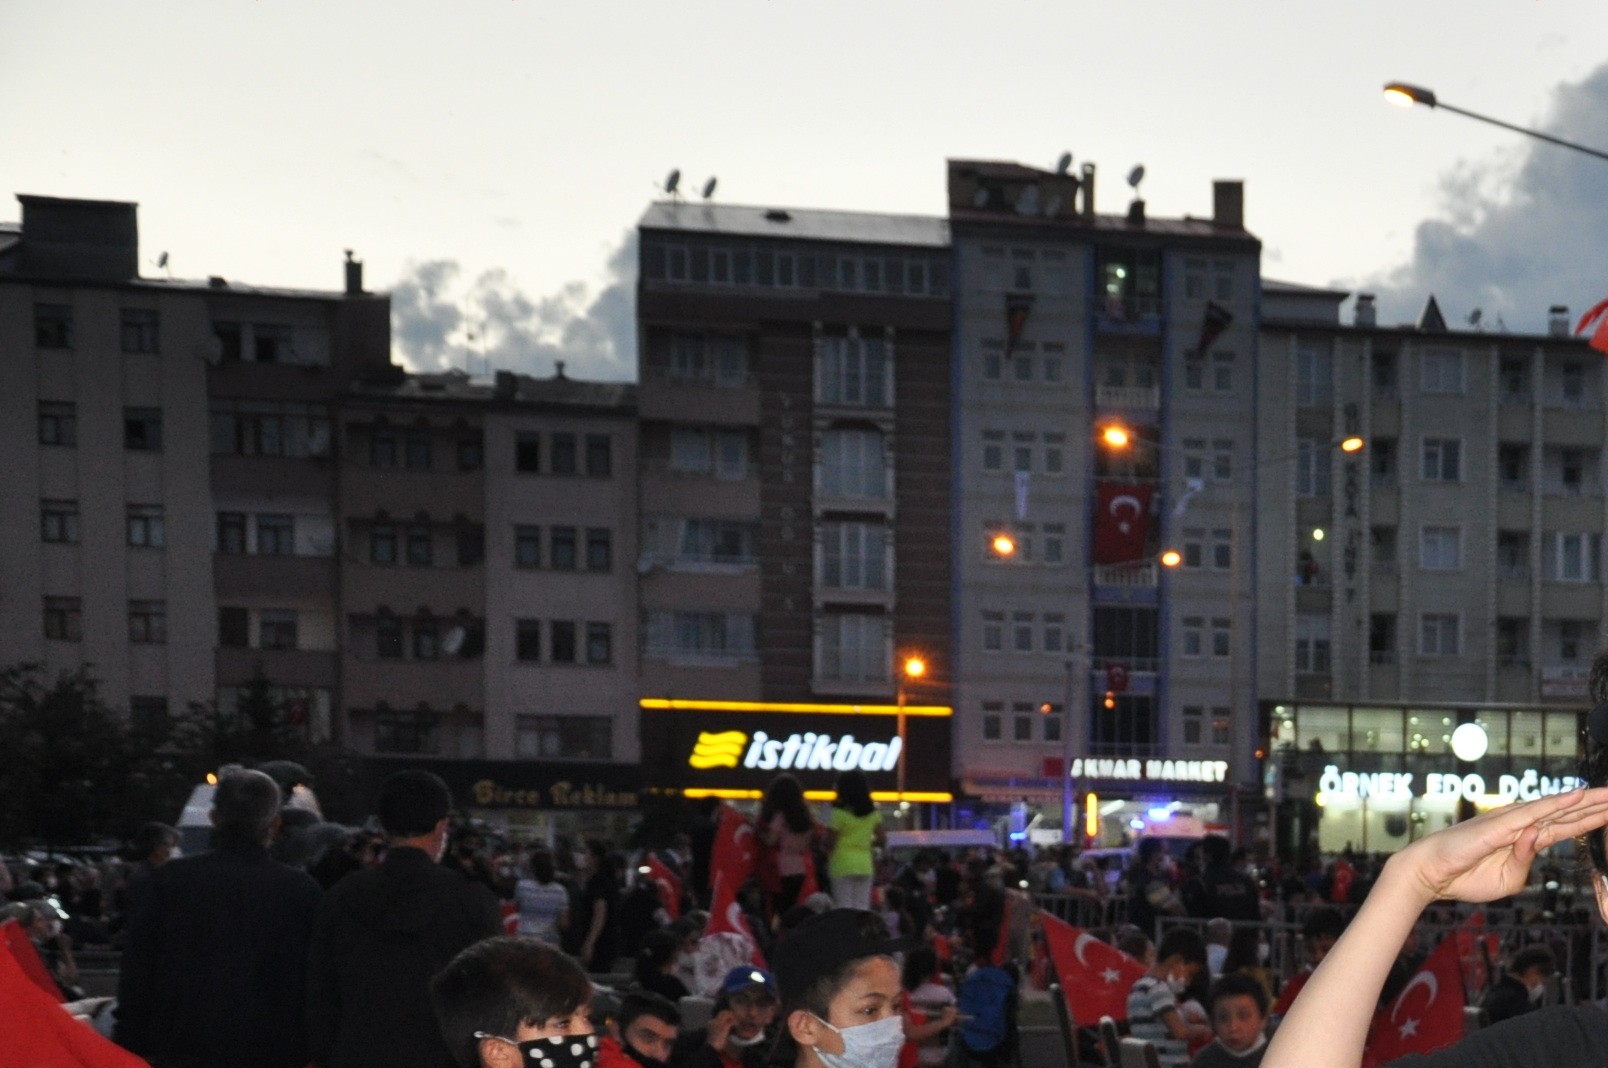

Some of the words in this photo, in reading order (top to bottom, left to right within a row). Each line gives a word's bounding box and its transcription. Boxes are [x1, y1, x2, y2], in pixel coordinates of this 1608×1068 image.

[744, 731, 903, 772] istikbal
[1146, 760, 1228, 782] MARKET
[1319, 765, 1413, 800] ÖRNEK
[1426, 773, 1486, 802] EDO
